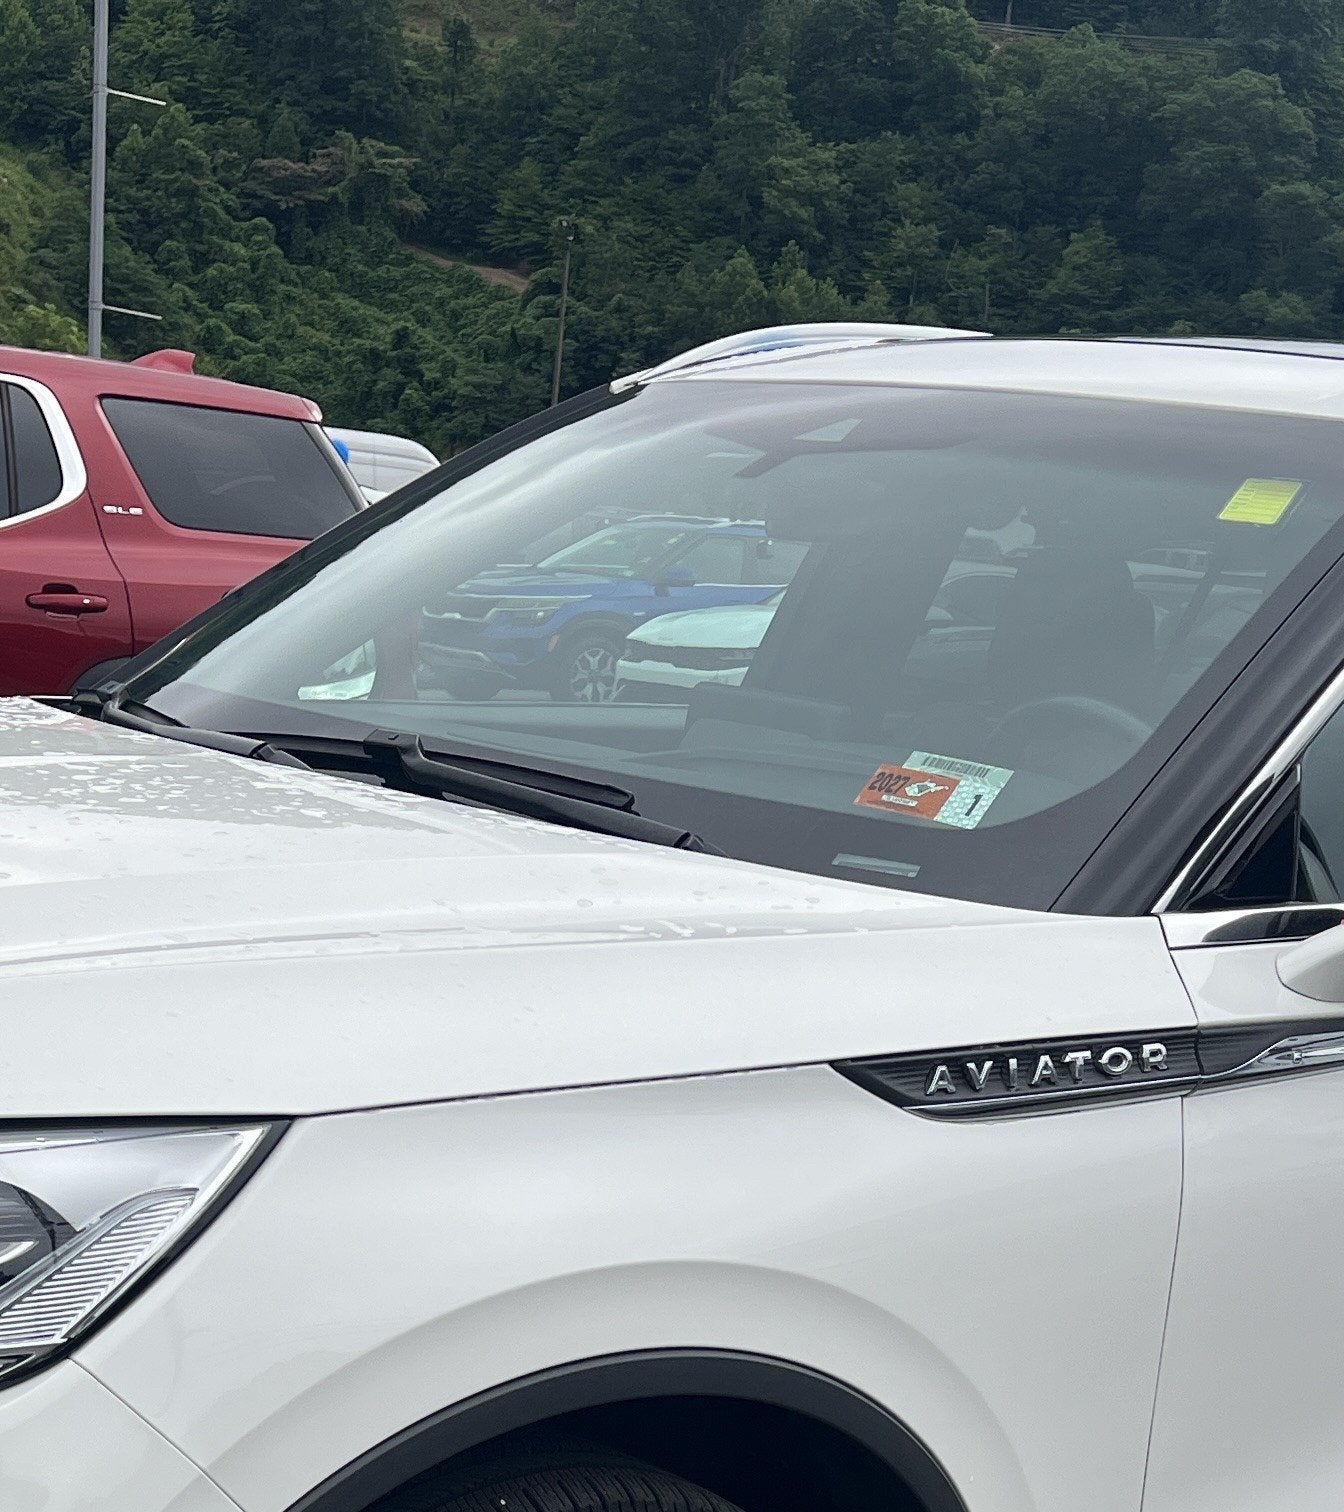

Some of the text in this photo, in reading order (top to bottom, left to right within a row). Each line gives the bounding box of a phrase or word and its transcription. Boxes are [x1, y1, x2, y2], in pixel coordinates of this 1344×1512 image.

[869, 771, 910, 796] 2027
[964, 794, 983, 817] 1
[925, 1042, 1168, 1096] AVIATOR
